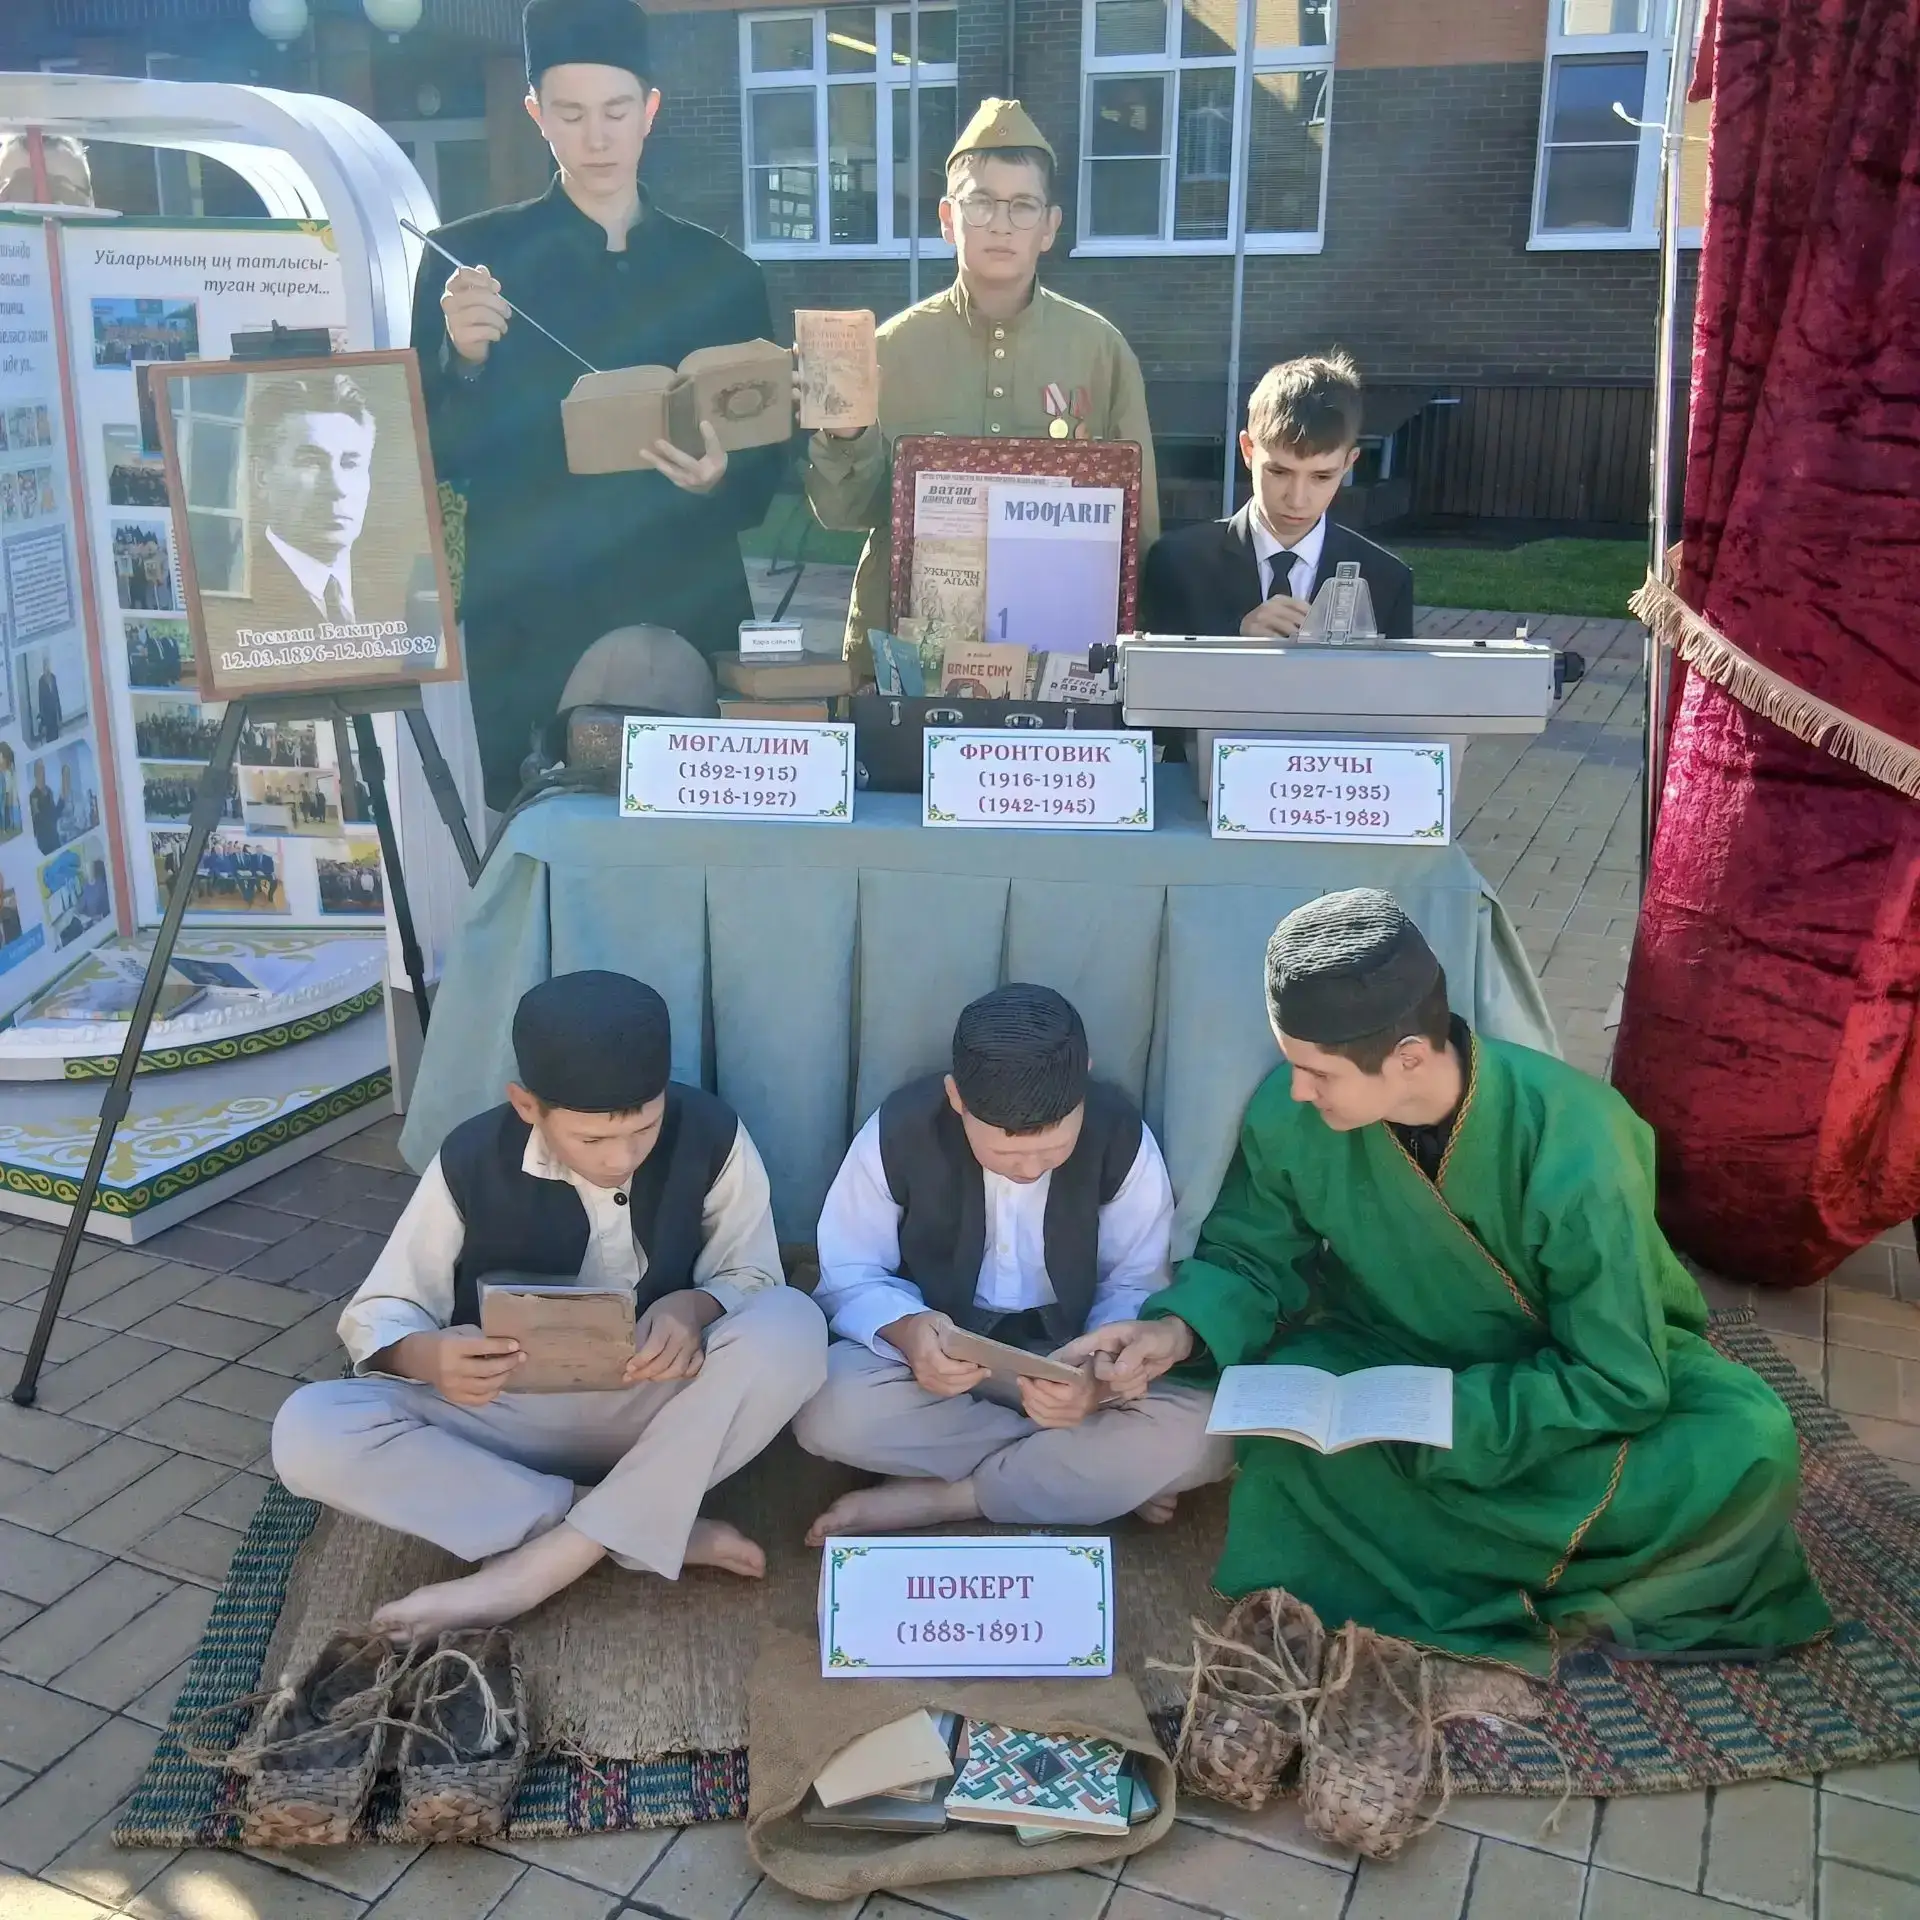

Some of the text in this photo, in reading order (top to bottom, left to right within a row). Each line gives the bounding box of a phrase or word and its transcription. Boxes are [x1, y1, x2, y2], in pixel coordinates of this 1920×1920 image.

[94, 249, 329, 270] Уйларымның иң татлысы-
[204, 278, 330, 297] туган җирем...
[924, 566, 980, 580] УКЫТУЧЫ
[943, 577, 979, 588] АПАМ
[236, 620, 408, 646] Госман Бакиров
[997, 607, 1008, 639] 1
[668, 733, 809, 756] МӨГАЛЛИМ
[960, 743, 1111, 763] ФРОНТОВИК
[678, 761, 797, 782] (1892-1915)
[1286, 755, 1373, 774] ЯЗУЧЫ
[978, 771, 1096, 789] (1916-1918)
[678, 787, 796, 807] (1918-1927)
[1269, 782, 1390, 801] (1927-1935)
[978, 796, 1096, 815] (1942-1945)
[1269, 807, 1390, 828] (1945-1982)
[906, 1575, 1034, 1600] ШӘКЕРТ
[897, 1619, 1044, 1645] (1883-1891)
